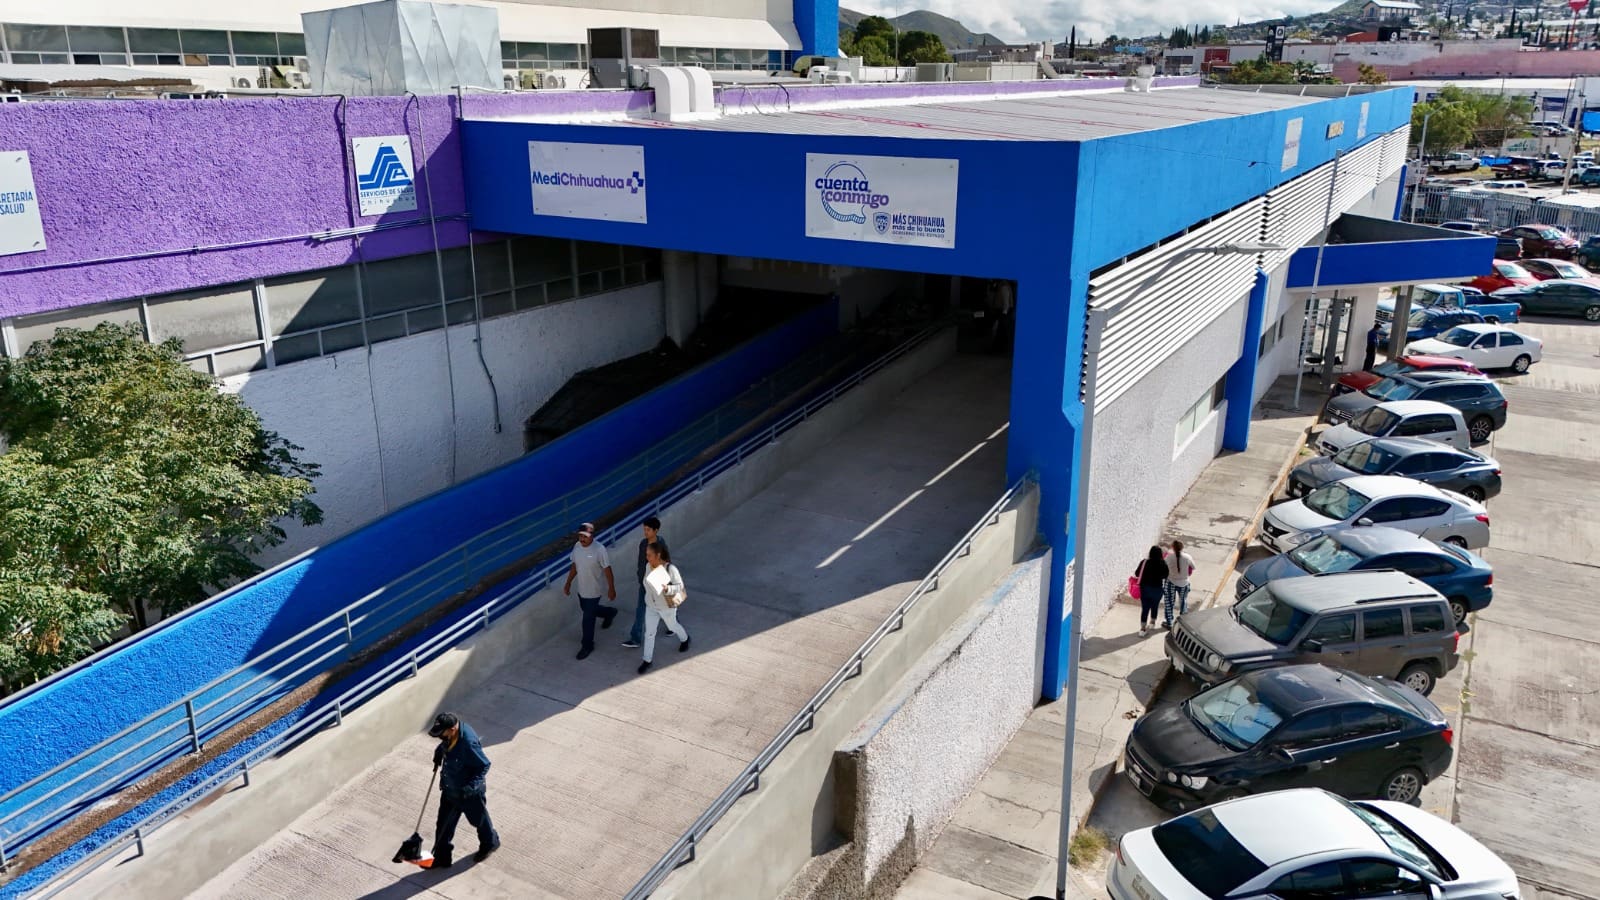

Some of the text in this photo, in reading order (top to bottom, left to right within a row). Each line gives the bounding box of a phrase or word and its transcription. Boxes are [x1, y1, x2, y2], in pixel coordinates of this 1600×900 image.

[532, 171, 624, 189] MediChihuahua
[815, 177, 869, 192] cuenta
[0, 190, 33, 203] RETARÍA
[825, 190, 889, 209] conmigo
[0, 203, 25, 215] SALUD
[892, 213, 945, 228] MÁS CHIHUAHUA
